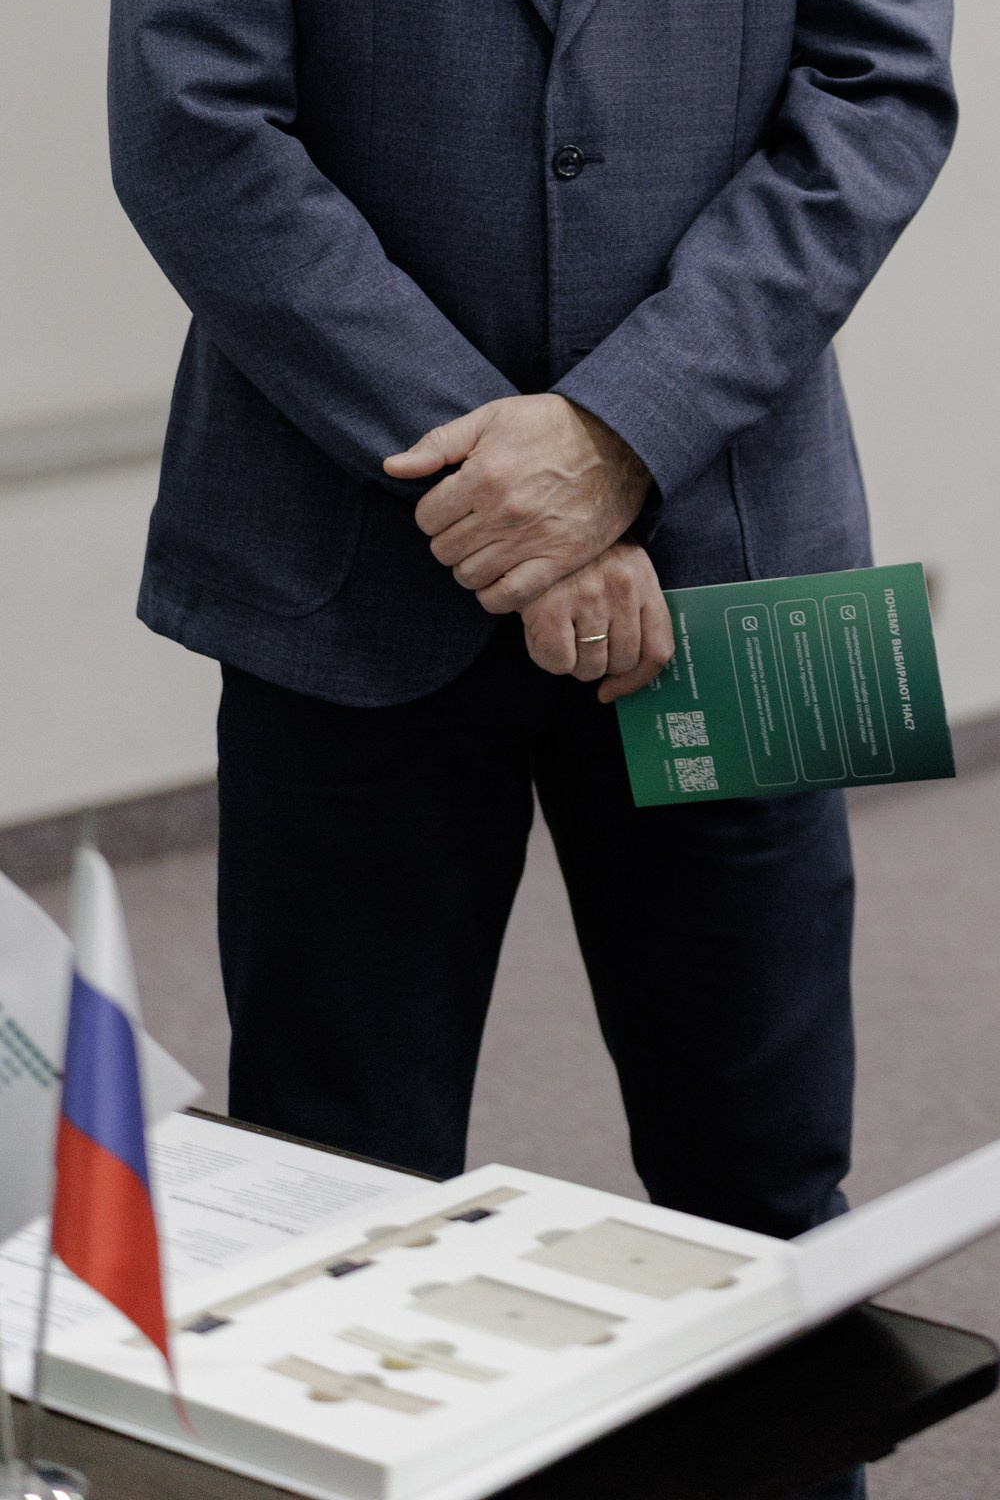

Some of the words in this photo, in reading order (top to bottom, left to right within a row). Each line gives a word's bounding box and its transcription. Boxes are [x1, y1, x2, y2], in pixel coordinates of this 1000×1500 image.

[682, 635, 692, 662] Трубные
[688, 663, 699, 699] Технологии
[884, 588, 899, 635] ПОЧЕМУ
[892, 639, 910, 701] ВЫБИРАЮТ
[903, 704, 915, 731] НАС?
[860, 681, 869, 704] подбор
[655, 714, 665, 741] telegram
